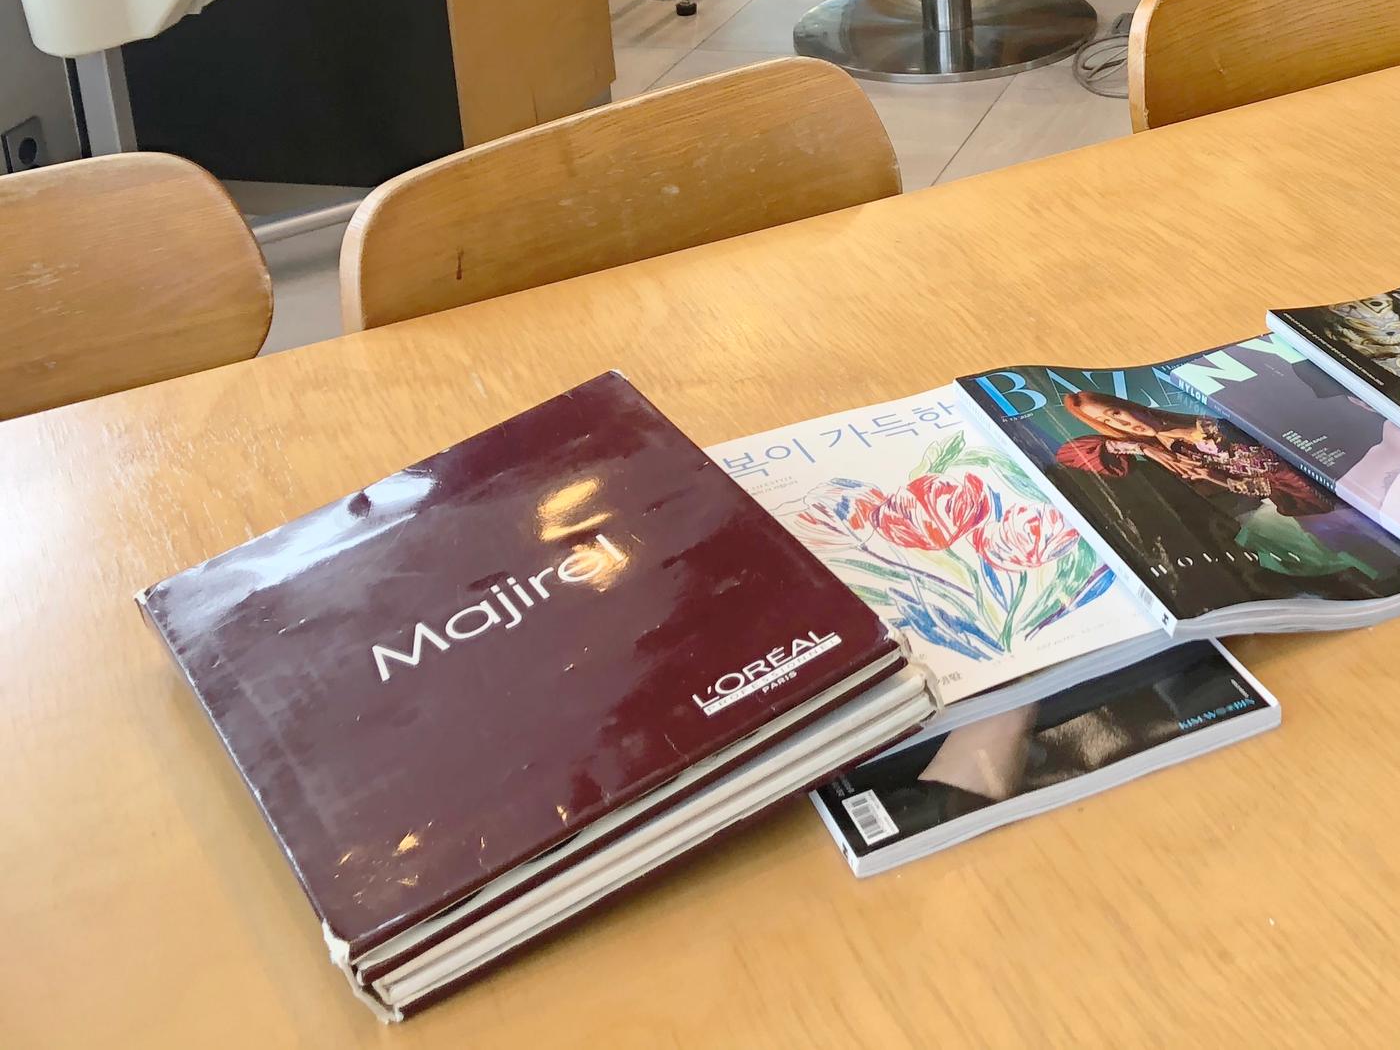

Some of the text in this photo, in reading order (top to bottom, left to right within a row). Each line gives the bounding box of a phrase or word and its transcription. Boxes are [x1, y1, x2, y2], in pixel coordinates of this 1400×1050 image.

[1178, 379, 1208, 406] NYLON
[819, 402, 962, 448] 가득한
[372, 534, 626, 683] Majirel
[691, 630, 836, 709] L'ORÉAL
[703, 636, 840, 715] PROFESSIONNEL
[762, 670, 798, 694] PARIS
